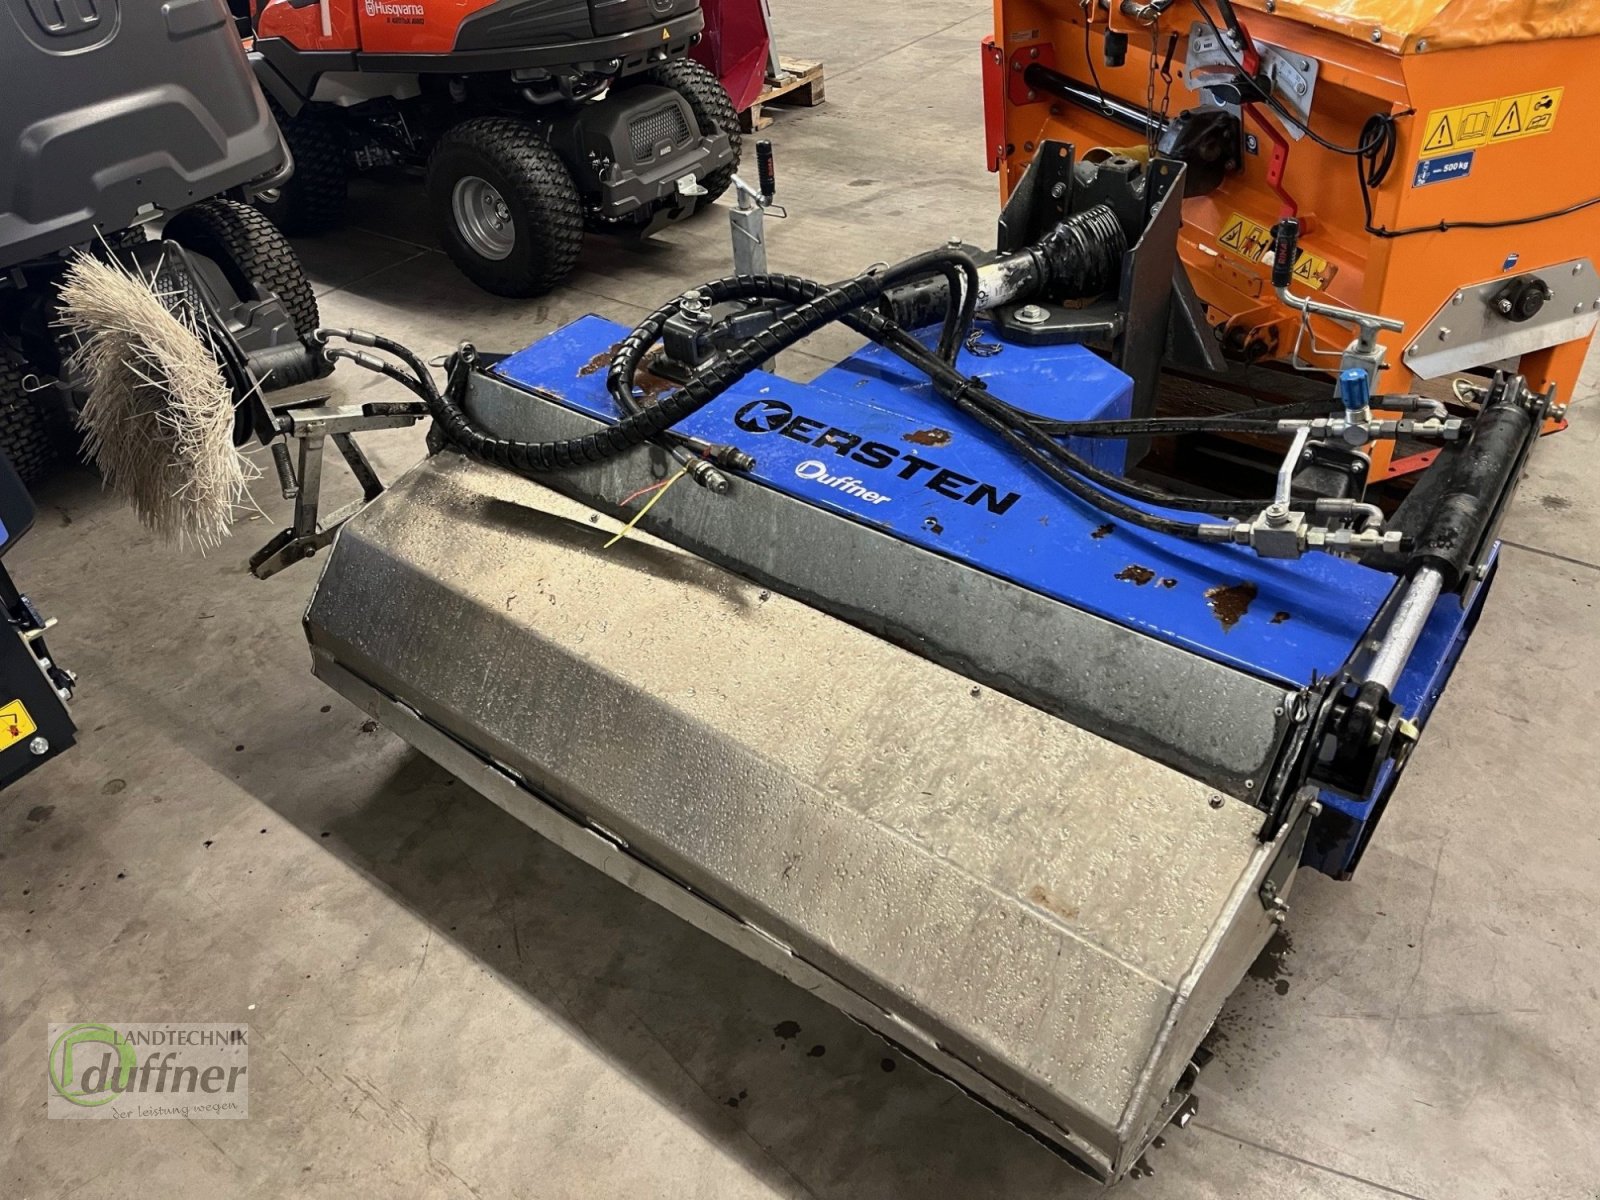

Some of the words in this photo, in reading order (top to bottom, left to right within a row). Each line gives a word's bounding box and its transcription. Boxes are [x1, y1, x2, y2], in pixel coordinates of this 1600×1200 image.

[375, 2, 424, 16] Husqvarna
[1443, 163, 1458, 172] 500
[1459, 161, 1469, 170] kg
[734, 400, 1021, 515] KERSTEN
[795, 460, 891, 505] Duffner
